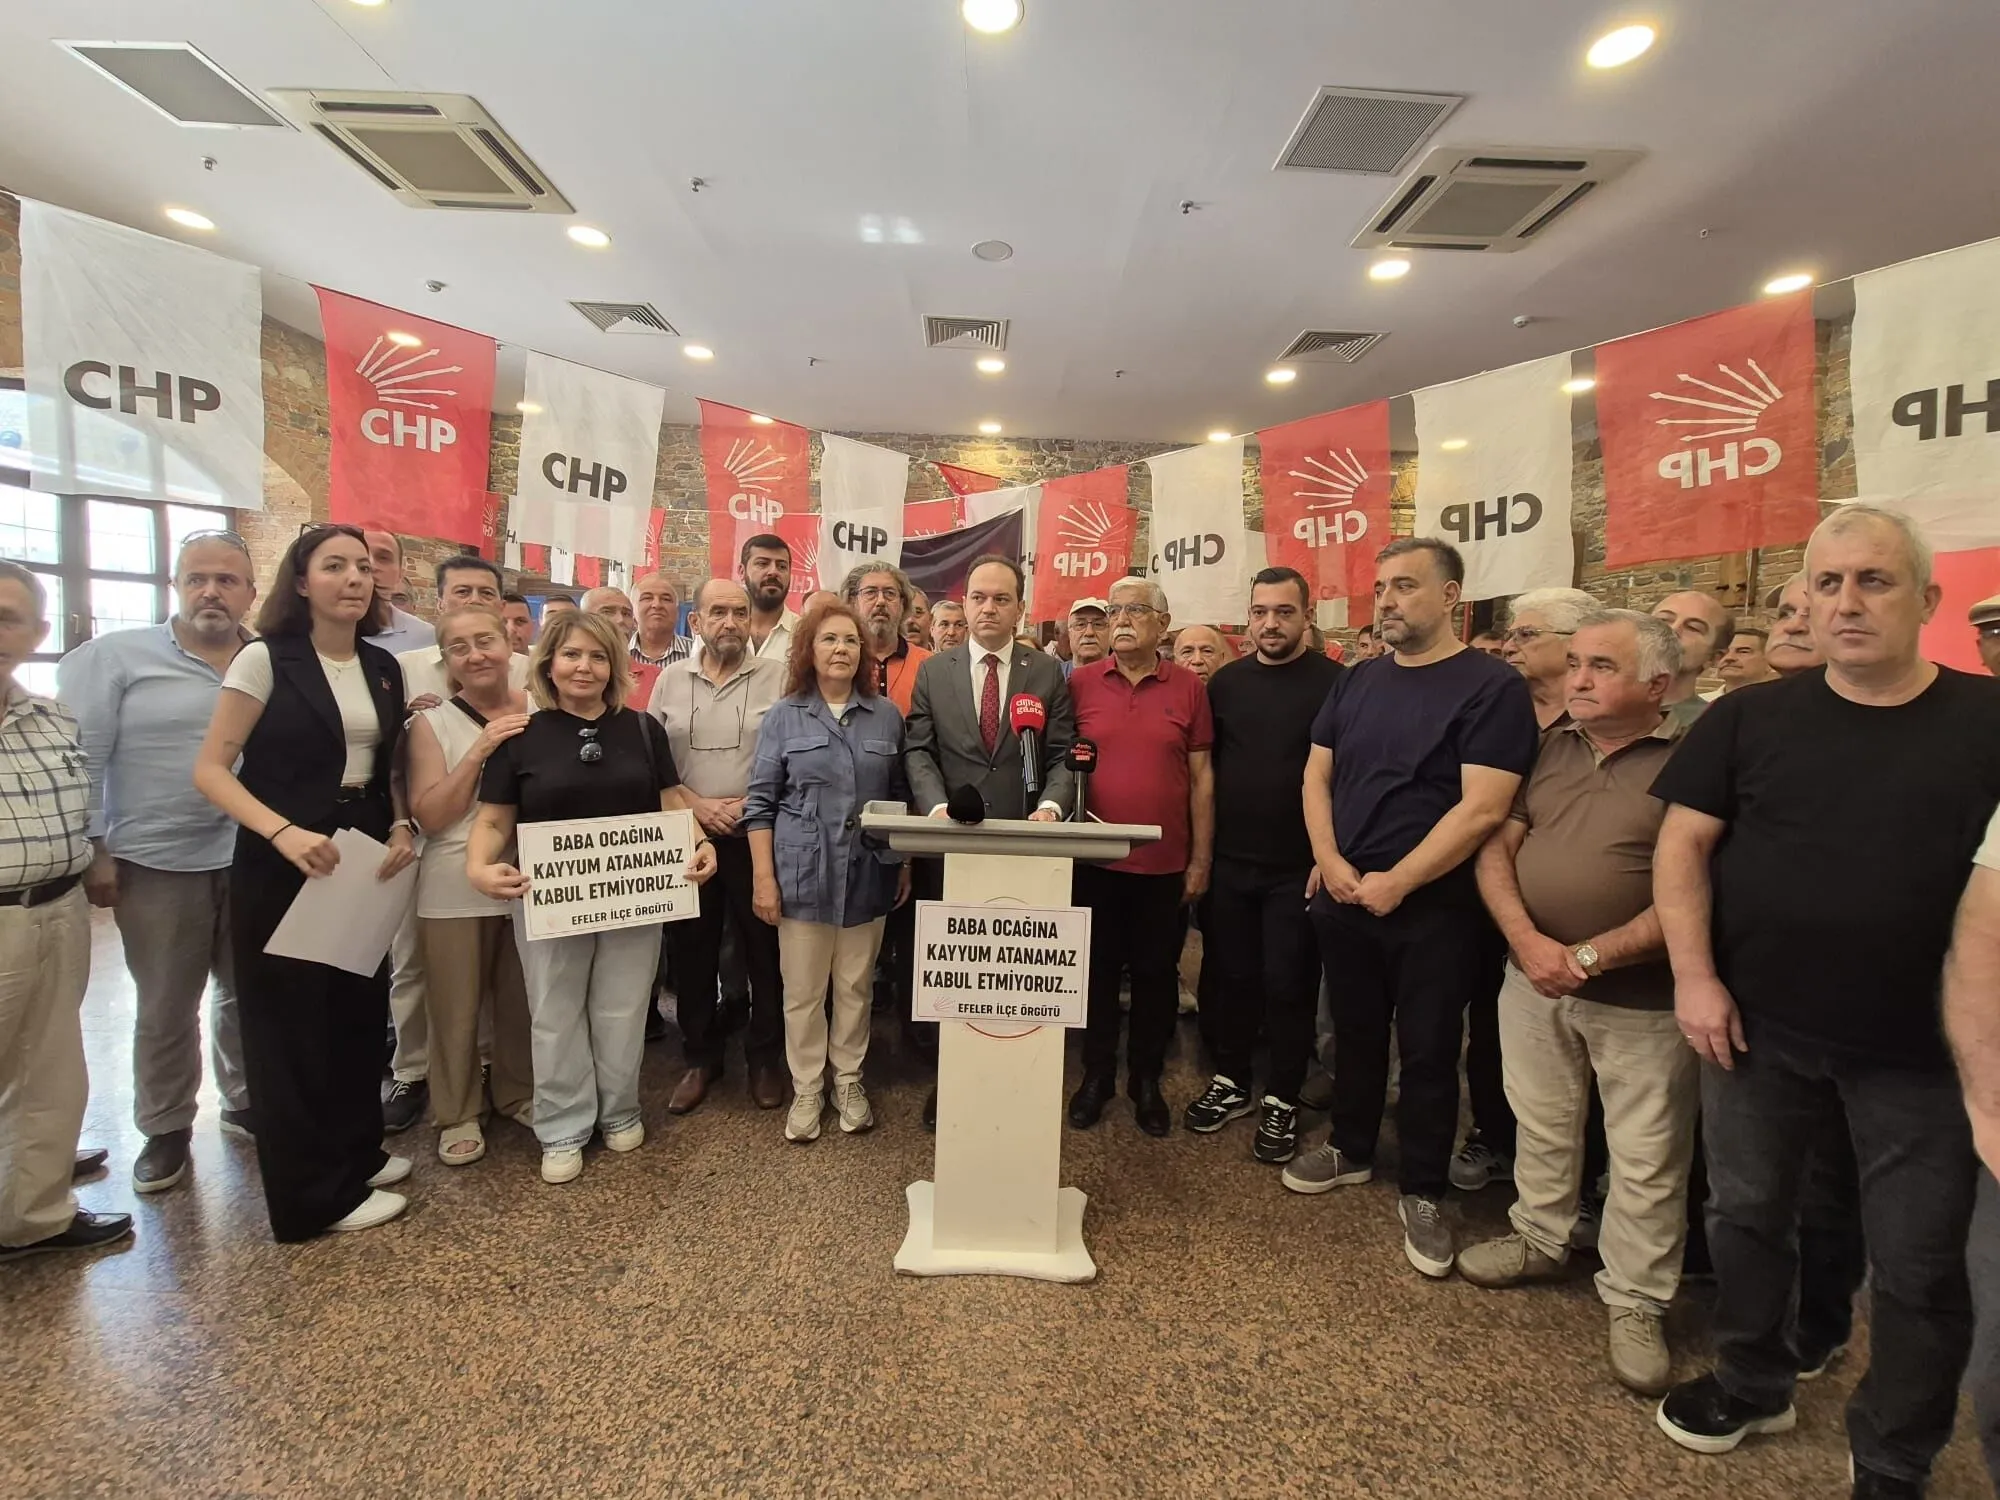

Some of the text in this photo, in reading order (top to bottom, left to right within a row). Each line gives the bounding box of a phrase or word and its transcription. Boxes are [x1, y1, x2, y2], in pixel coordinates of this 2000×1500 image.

[63, 360, 221, 424] CHP
[360, 408, 457, 453] CHP
[541, 453, 627, 501] CHP
[728, 493, 784, 526] CHP
[833, 520, 888, 555] CHP
[553, 825, 664, 852] BABA OCAĞINA
[534, 848, 683, 880] KAYYUM ATANAMAZ
[533, 874, 688, 906] KABUL ETMİYORUZ...
[572, 901, 674, 925] EFELER İLÇE ÖRGÜTÜ
[947, 916, 1058, 939] BABA OCAĞINA
[927, 944, 1077, 967] KAYYUM ATANAMAZ
[923, 969, 1078, 994] KABUL ETMİYORUZ...
[958, 1002, 1061, 1017] EFELER İLÇE ÖRGÜTÜ
